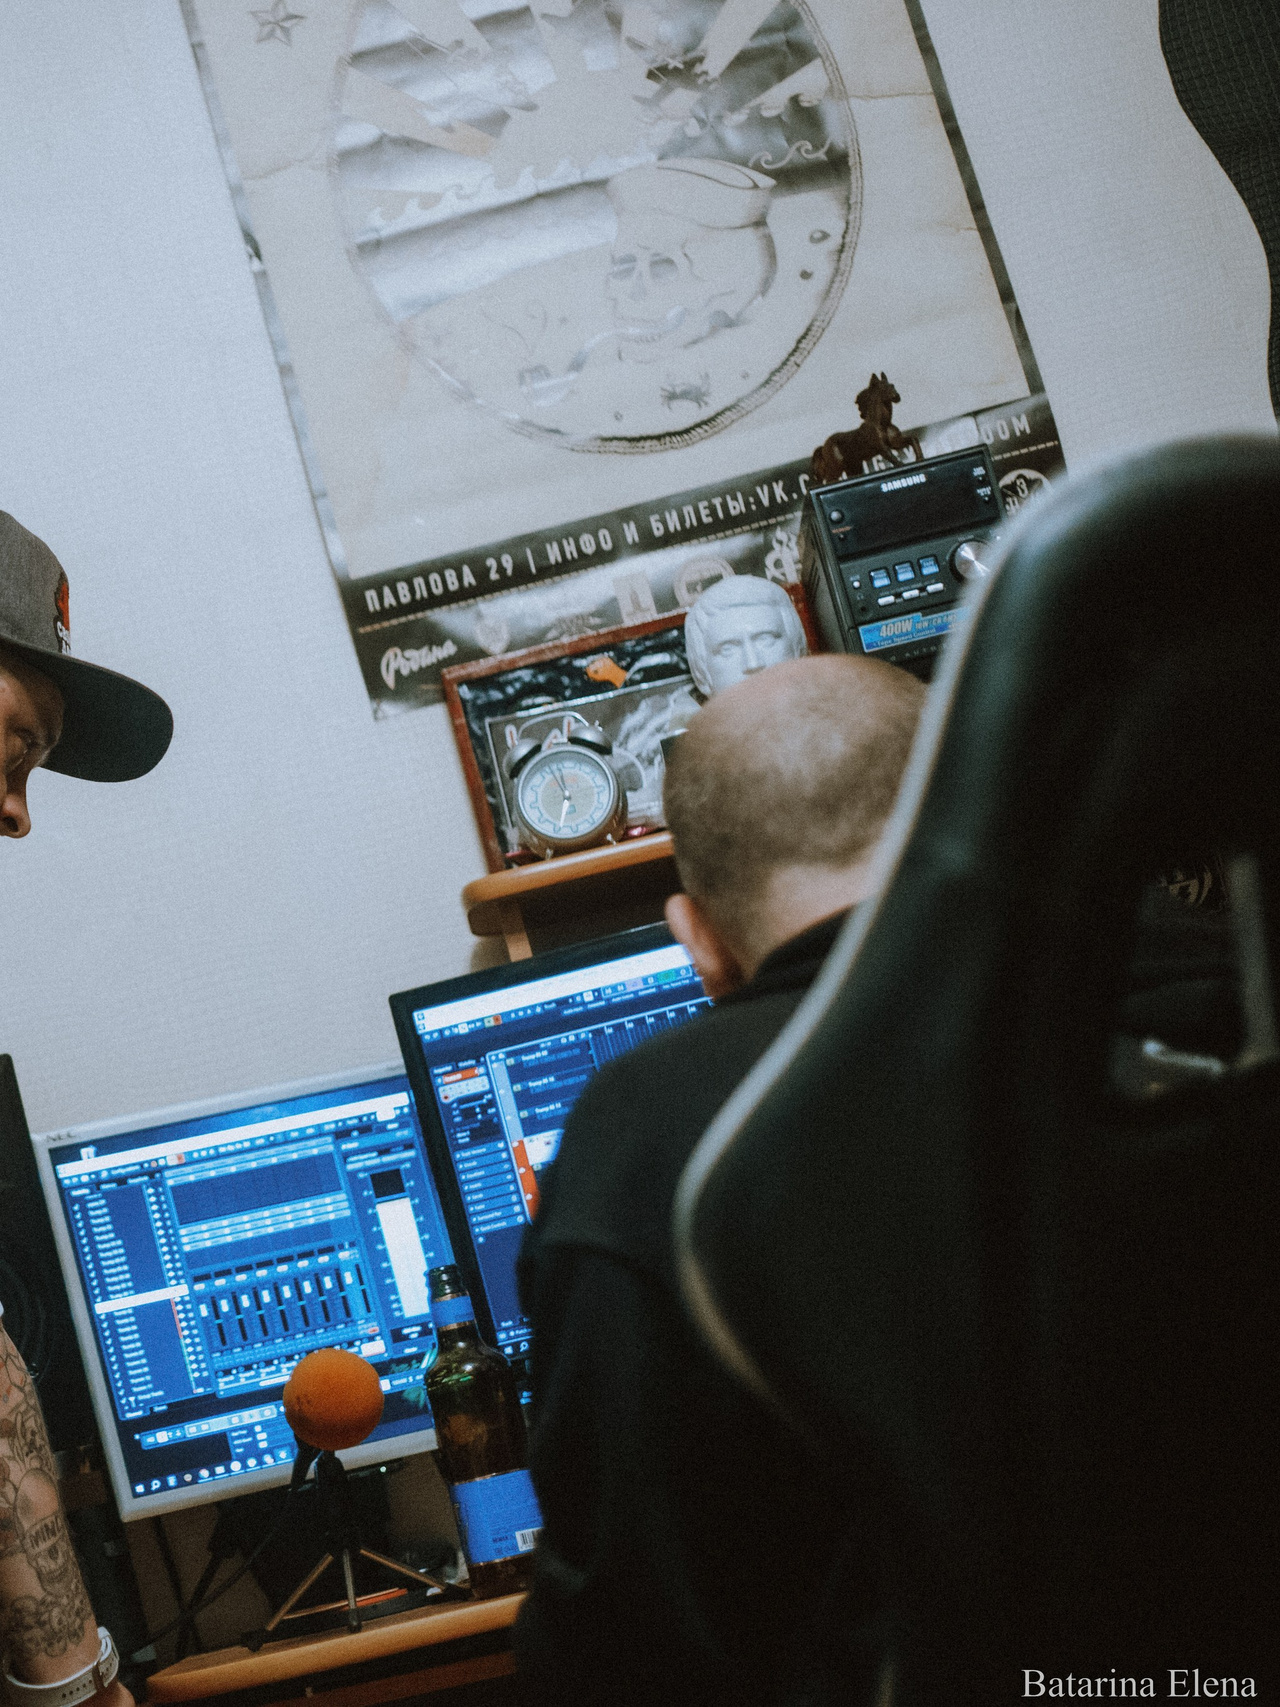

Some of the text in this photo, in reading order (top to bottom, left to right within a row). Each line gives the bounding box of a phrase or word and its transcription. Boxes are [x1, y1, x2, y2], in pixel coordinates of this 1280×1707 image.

[880, 472, 927, 493] SAMSUNG
[364, 563, 477, 613] ПАВЛОВА
[485, 553, 514, 582] 29
[545, 528, 613, 565] ИНФО
[623, 520, 640, 545] И
[879, 619, 913, 638] 400W
